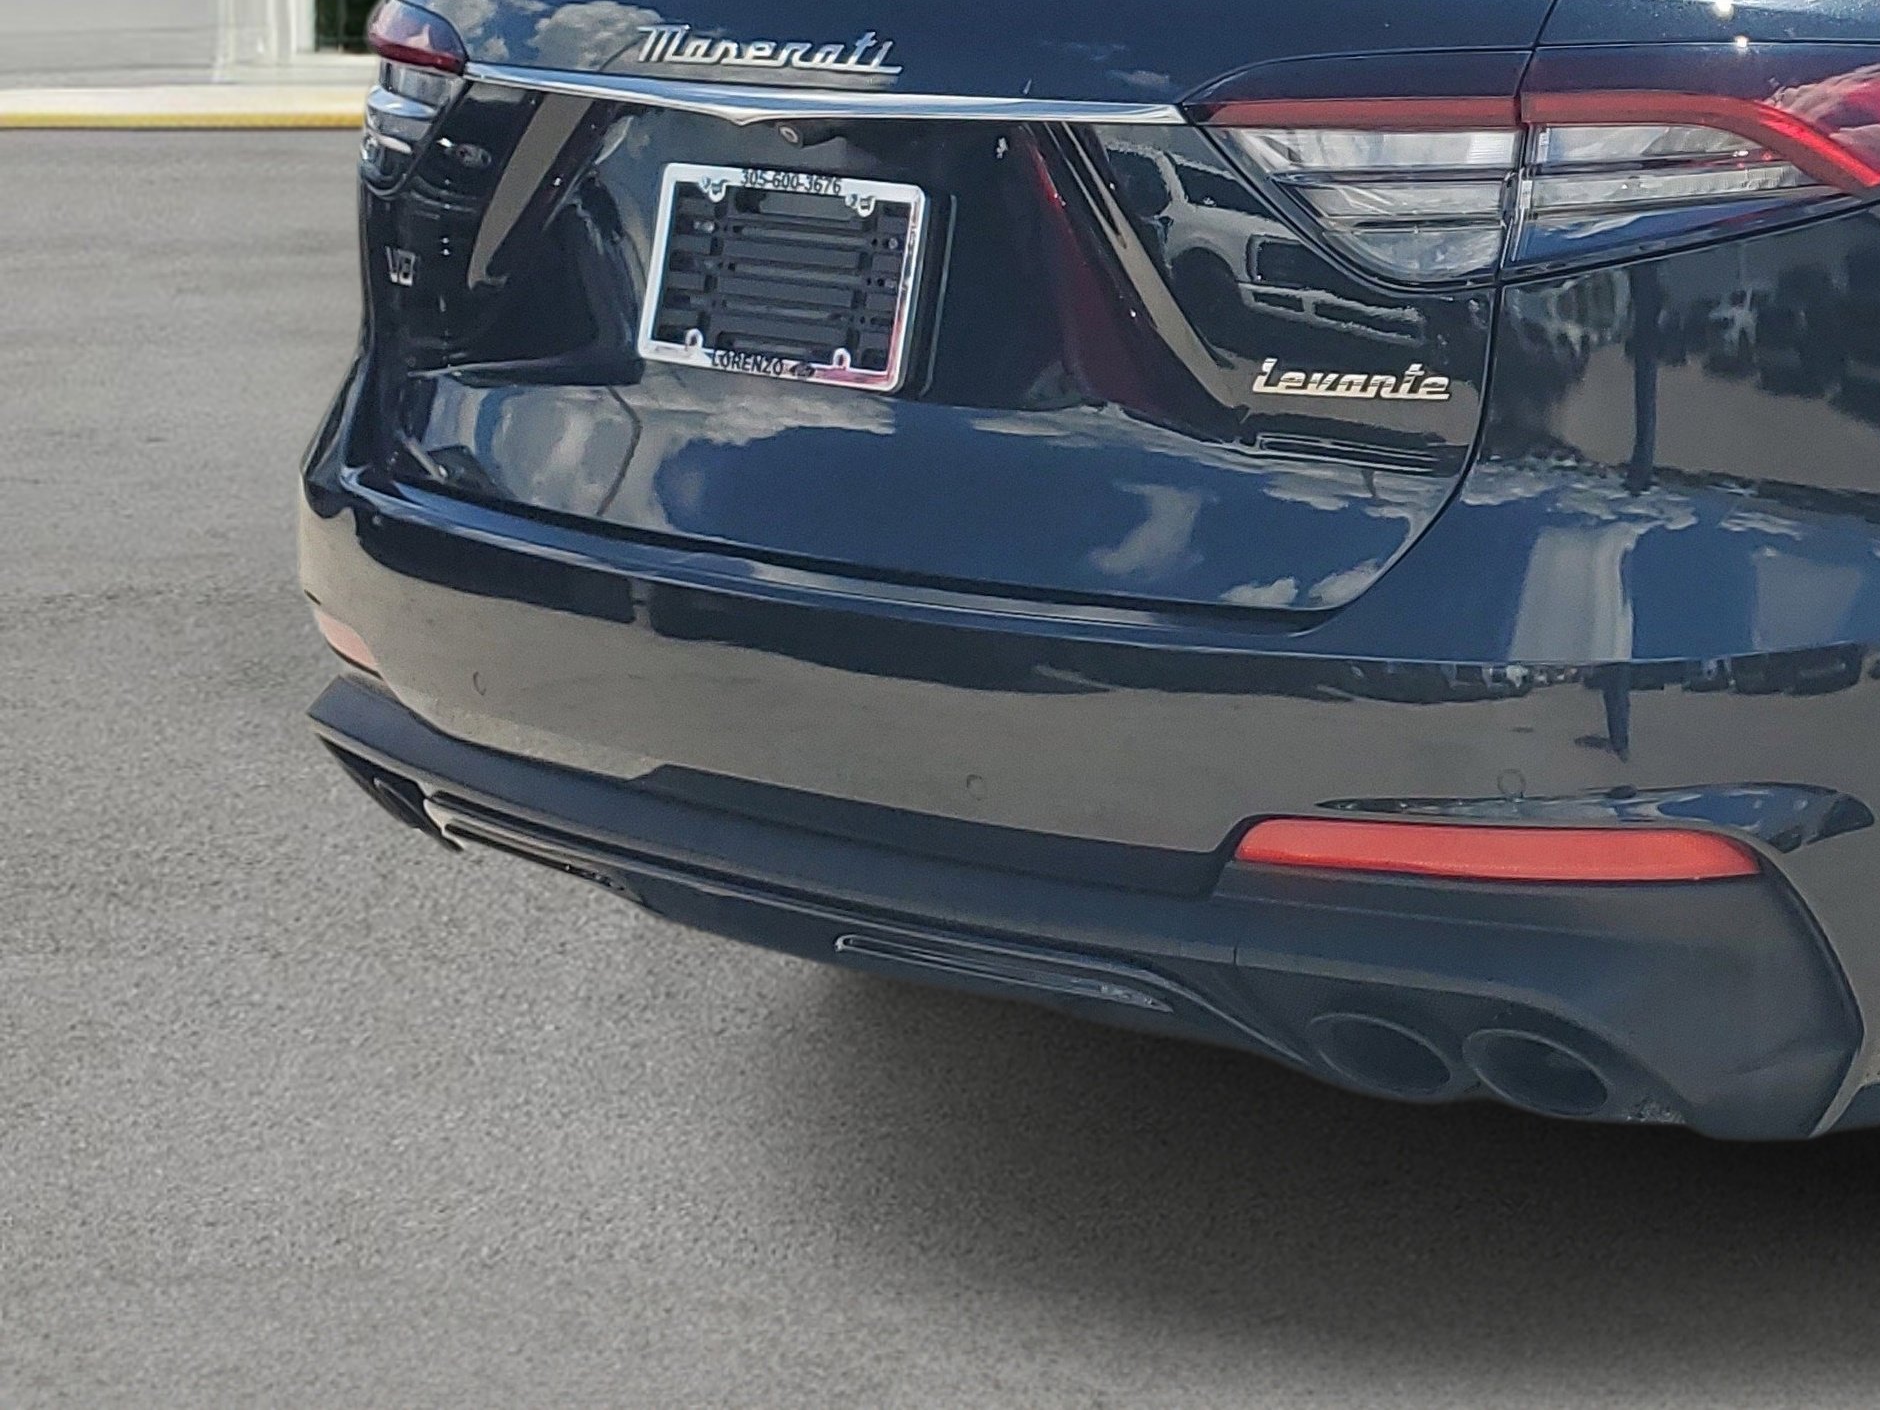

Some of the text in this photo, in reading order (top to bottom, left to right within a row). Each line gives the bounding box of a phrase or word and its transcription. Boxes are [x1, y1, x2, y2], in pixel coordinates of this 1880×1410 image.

[637, 24, 903, 74] Maserati
[711, 350, 784, 376] LORENZO
[1252, 357, 1450, 400] Levante
